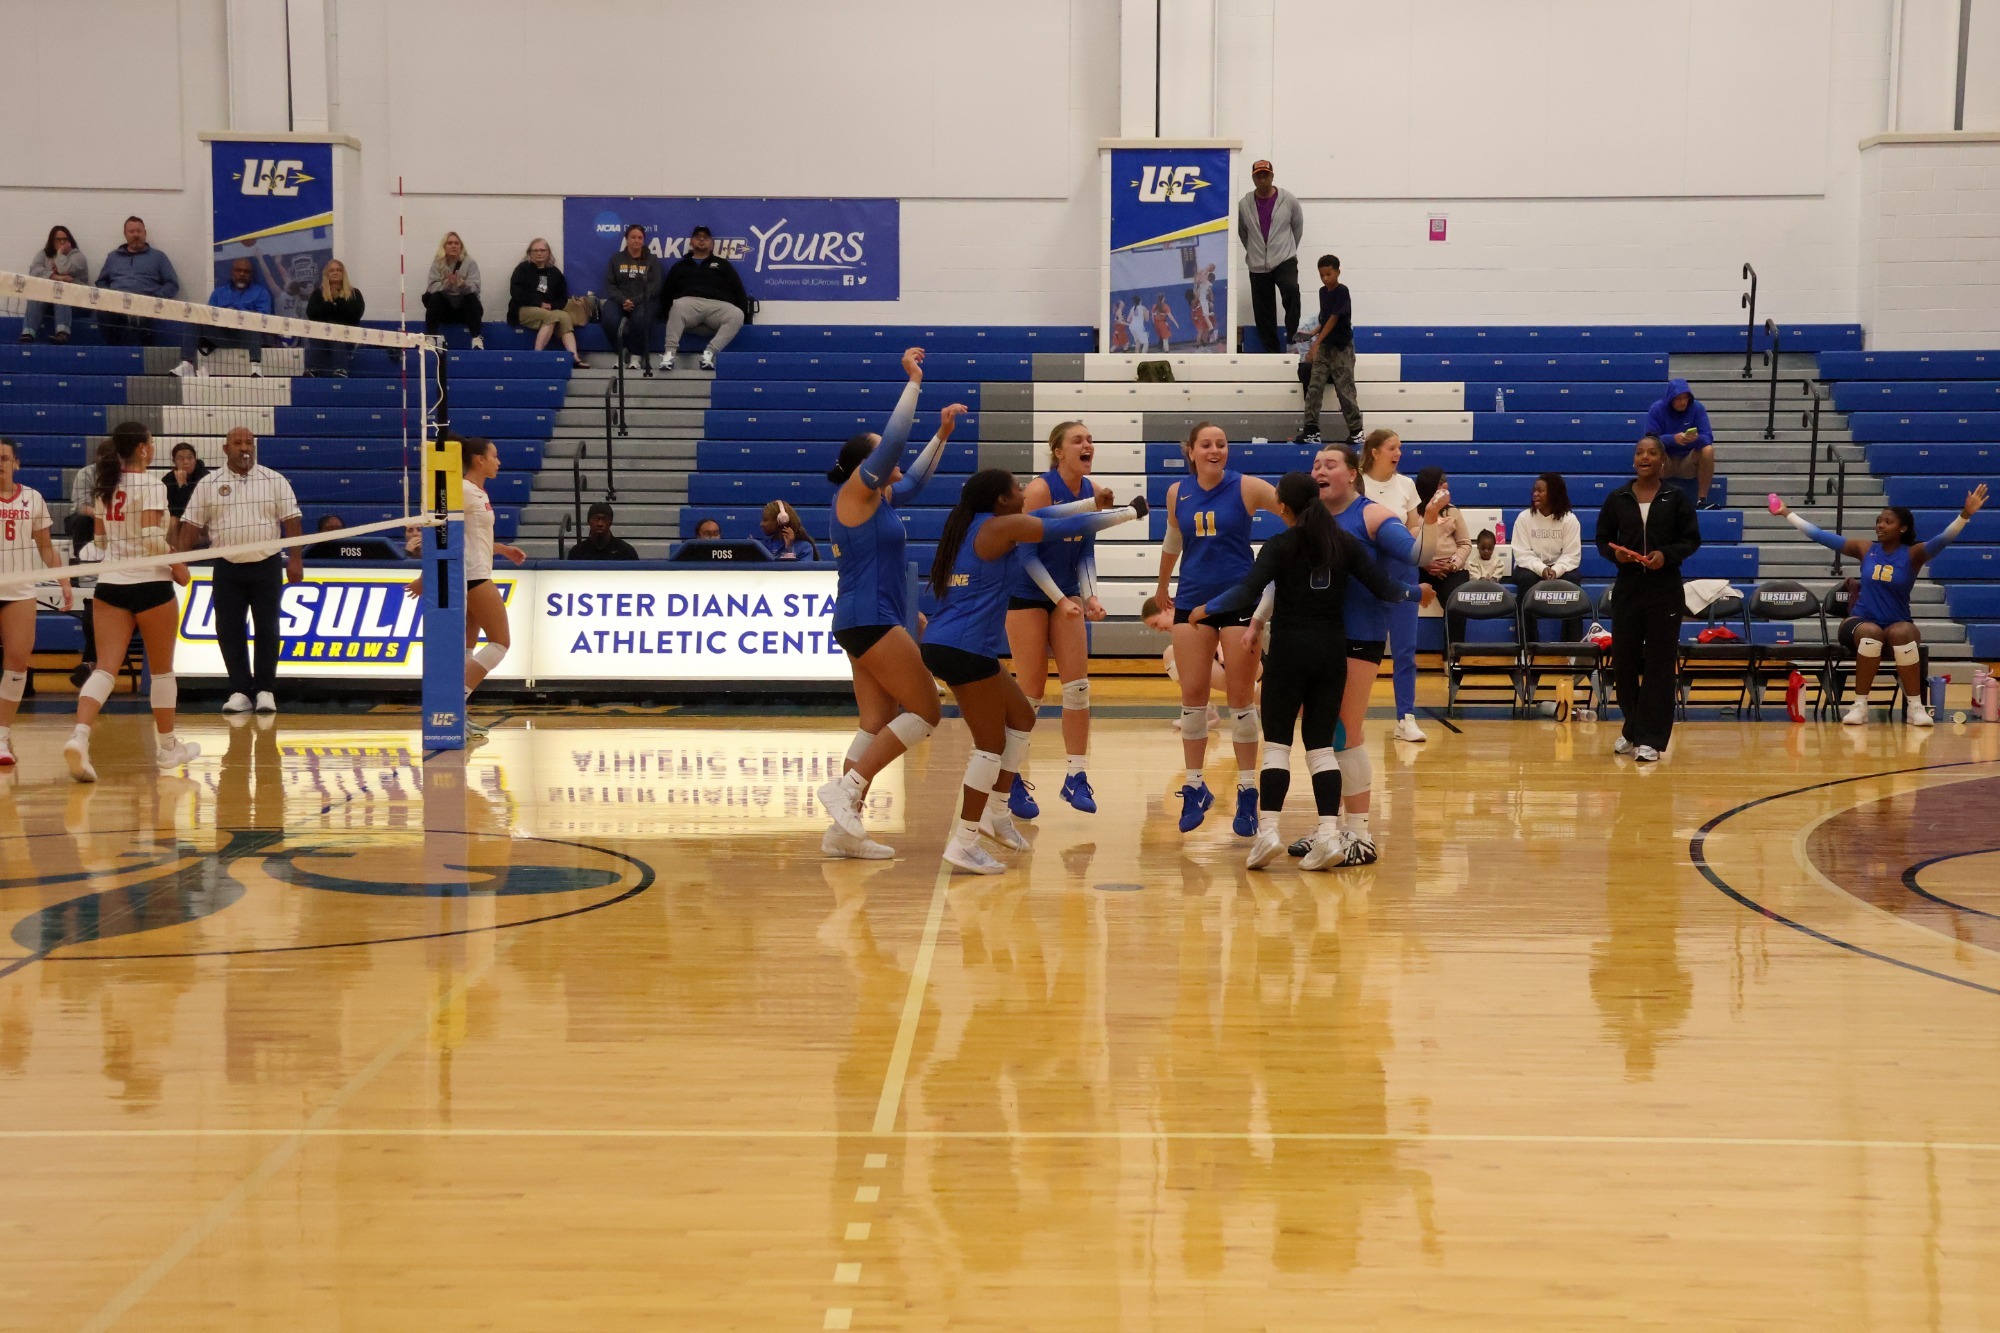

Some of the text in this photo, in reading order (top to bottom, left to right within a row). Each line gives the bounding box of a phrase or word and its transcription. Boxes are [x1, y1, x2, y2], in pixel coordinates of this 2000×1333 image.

[241, 159, 303, 197] UC
[1138, 166, 1201, 202] UC
[596, 224, 621, 232] NCAA
[106, 491, 127, 521] 12
[5, 520, 15, 540] 6
[1193, 511, 1217, 537] 11
[340, 547, 362, 557] POSS
[712, 549, 733, 559] POSS
[1871, 564, 1894, 582] 12
[1459, 593, 1502, 601] URSULINE
[1535, 591, 1579, 600] URSULINE
[1761, 593, 1806, 601] URSULINE
[185, 585, 423, 638] USULI
[546, 593, 836, 617] SISTER DIANA STA
[292, 642, 399, 657] ARROWS
[570, 630, 844, 654] ATHLETIC CENTE
[432, 713, 454, 726] UC
